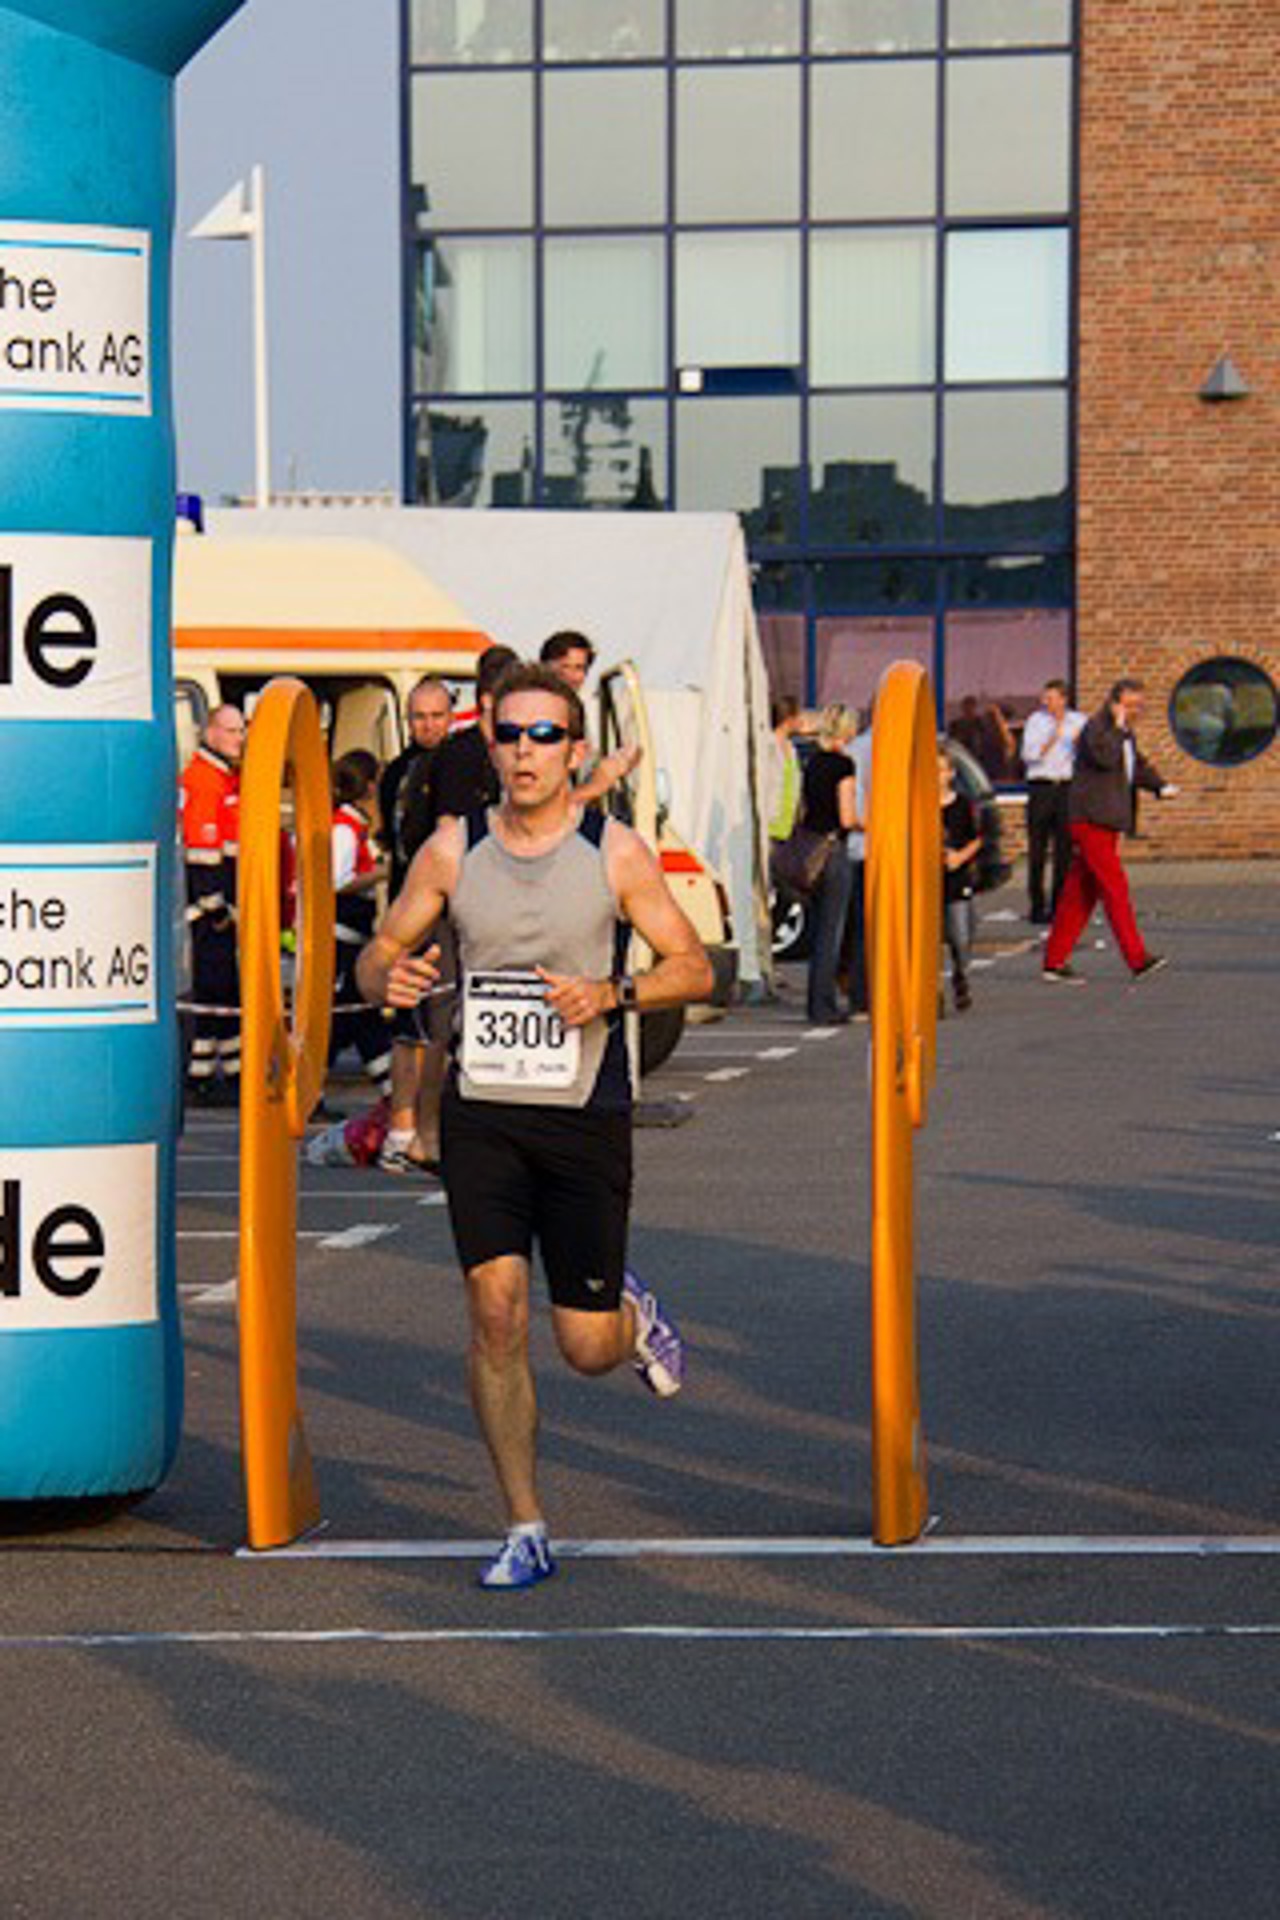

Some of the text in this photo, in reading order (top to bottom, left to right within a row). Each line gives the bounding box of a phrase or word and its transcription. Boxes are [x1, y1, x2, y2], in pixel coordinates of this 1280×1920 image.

[99, 331, 143, 377] AG
[0, 888, 65, 930] he
[107, 944, 149, 986] AG
[476, 1011, 565, 1048] 3300
